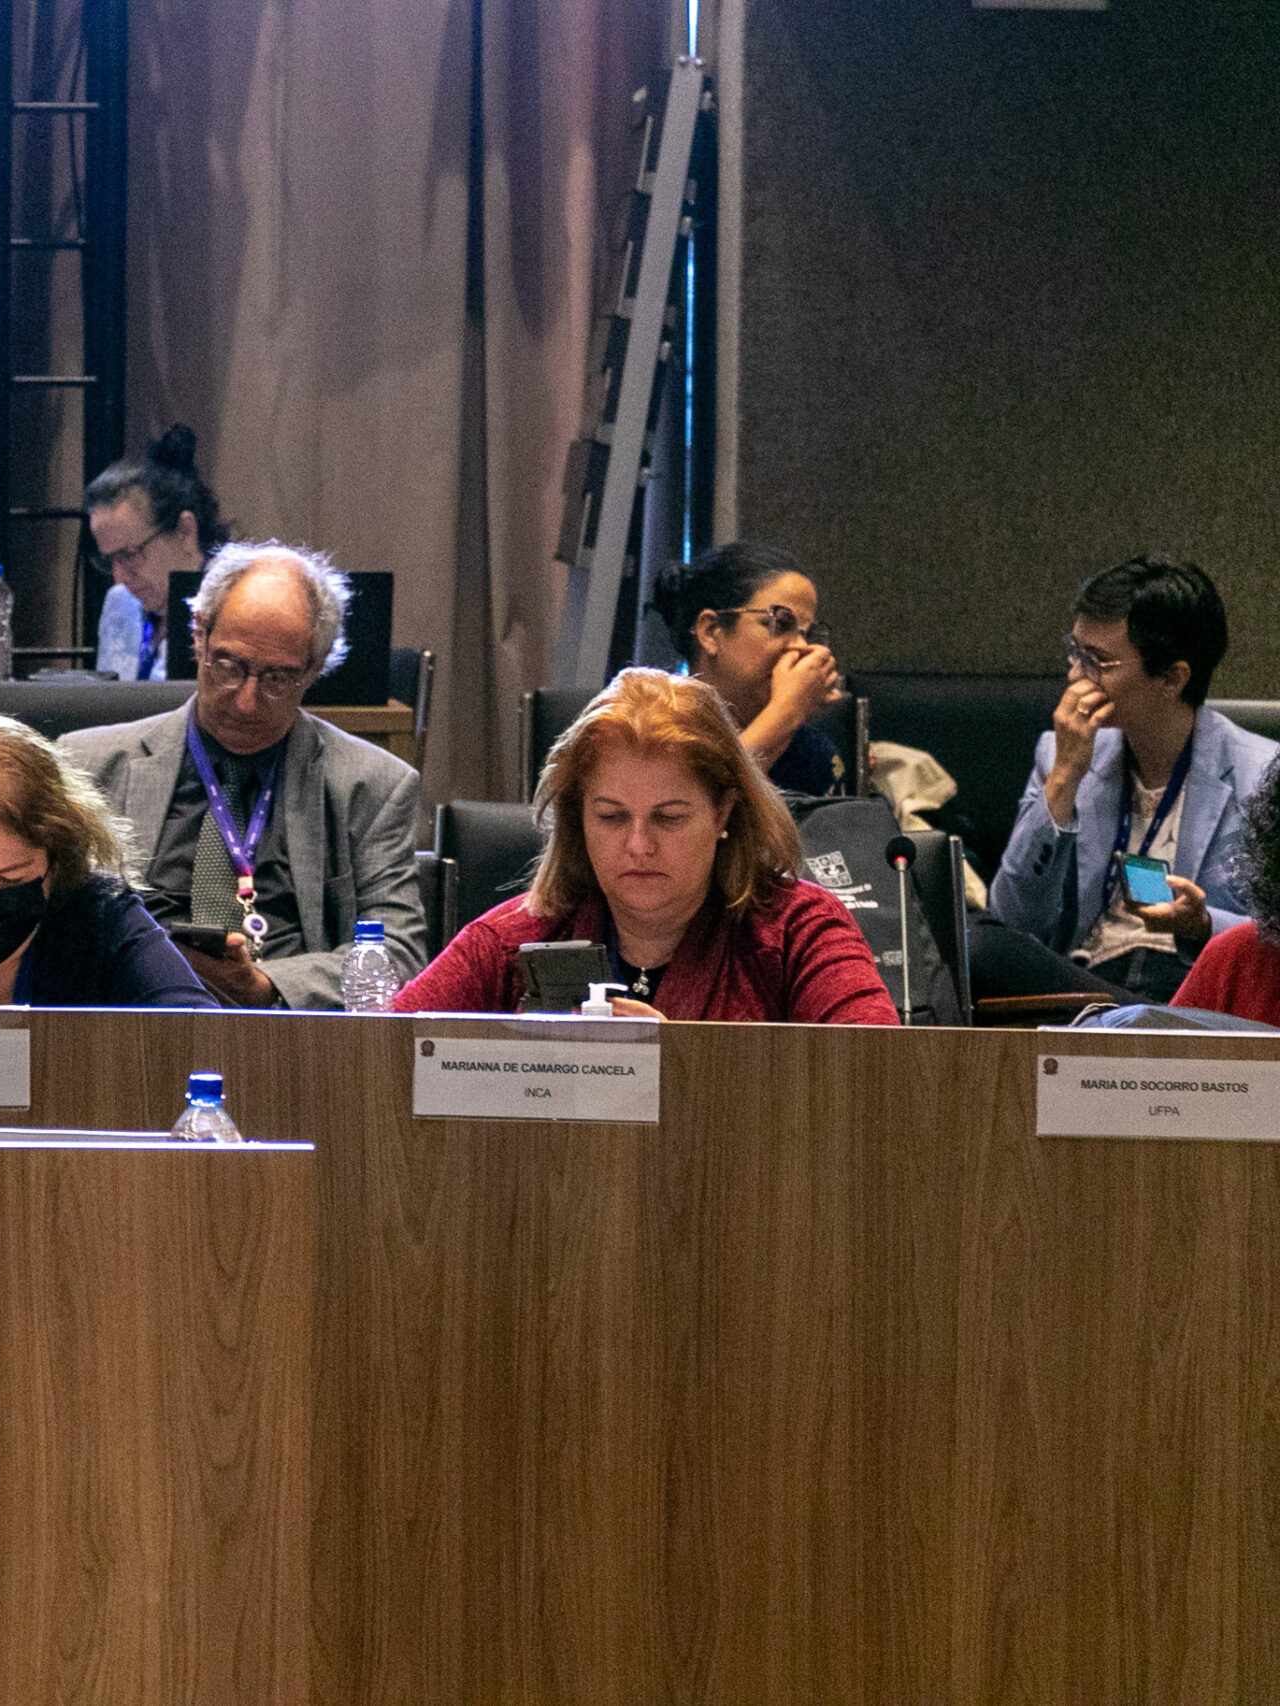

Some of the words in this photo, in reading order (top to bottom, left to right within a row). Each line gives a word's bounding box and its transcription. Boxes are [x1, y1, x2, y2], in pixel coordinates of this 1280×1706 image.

[441, 1060, 501, 1072] MARIANNA
[503, 1062, 519, 1073] DE
[521, 1063, 579, 1074] CAMARGO
[581, 1064, 636, 1076] CANCELA
[1080, 1079, 1118, 1090] MARIA
[1120, 1080, 1138, 1091] DO
[1140, 1081, 1199, 1092] SOCORRO
[1201, 1082, 1249, 1093] BASTOS
[524, 1087, 552, 1098] INCA
[1148, 1106, 1181, 1117] UFPA
